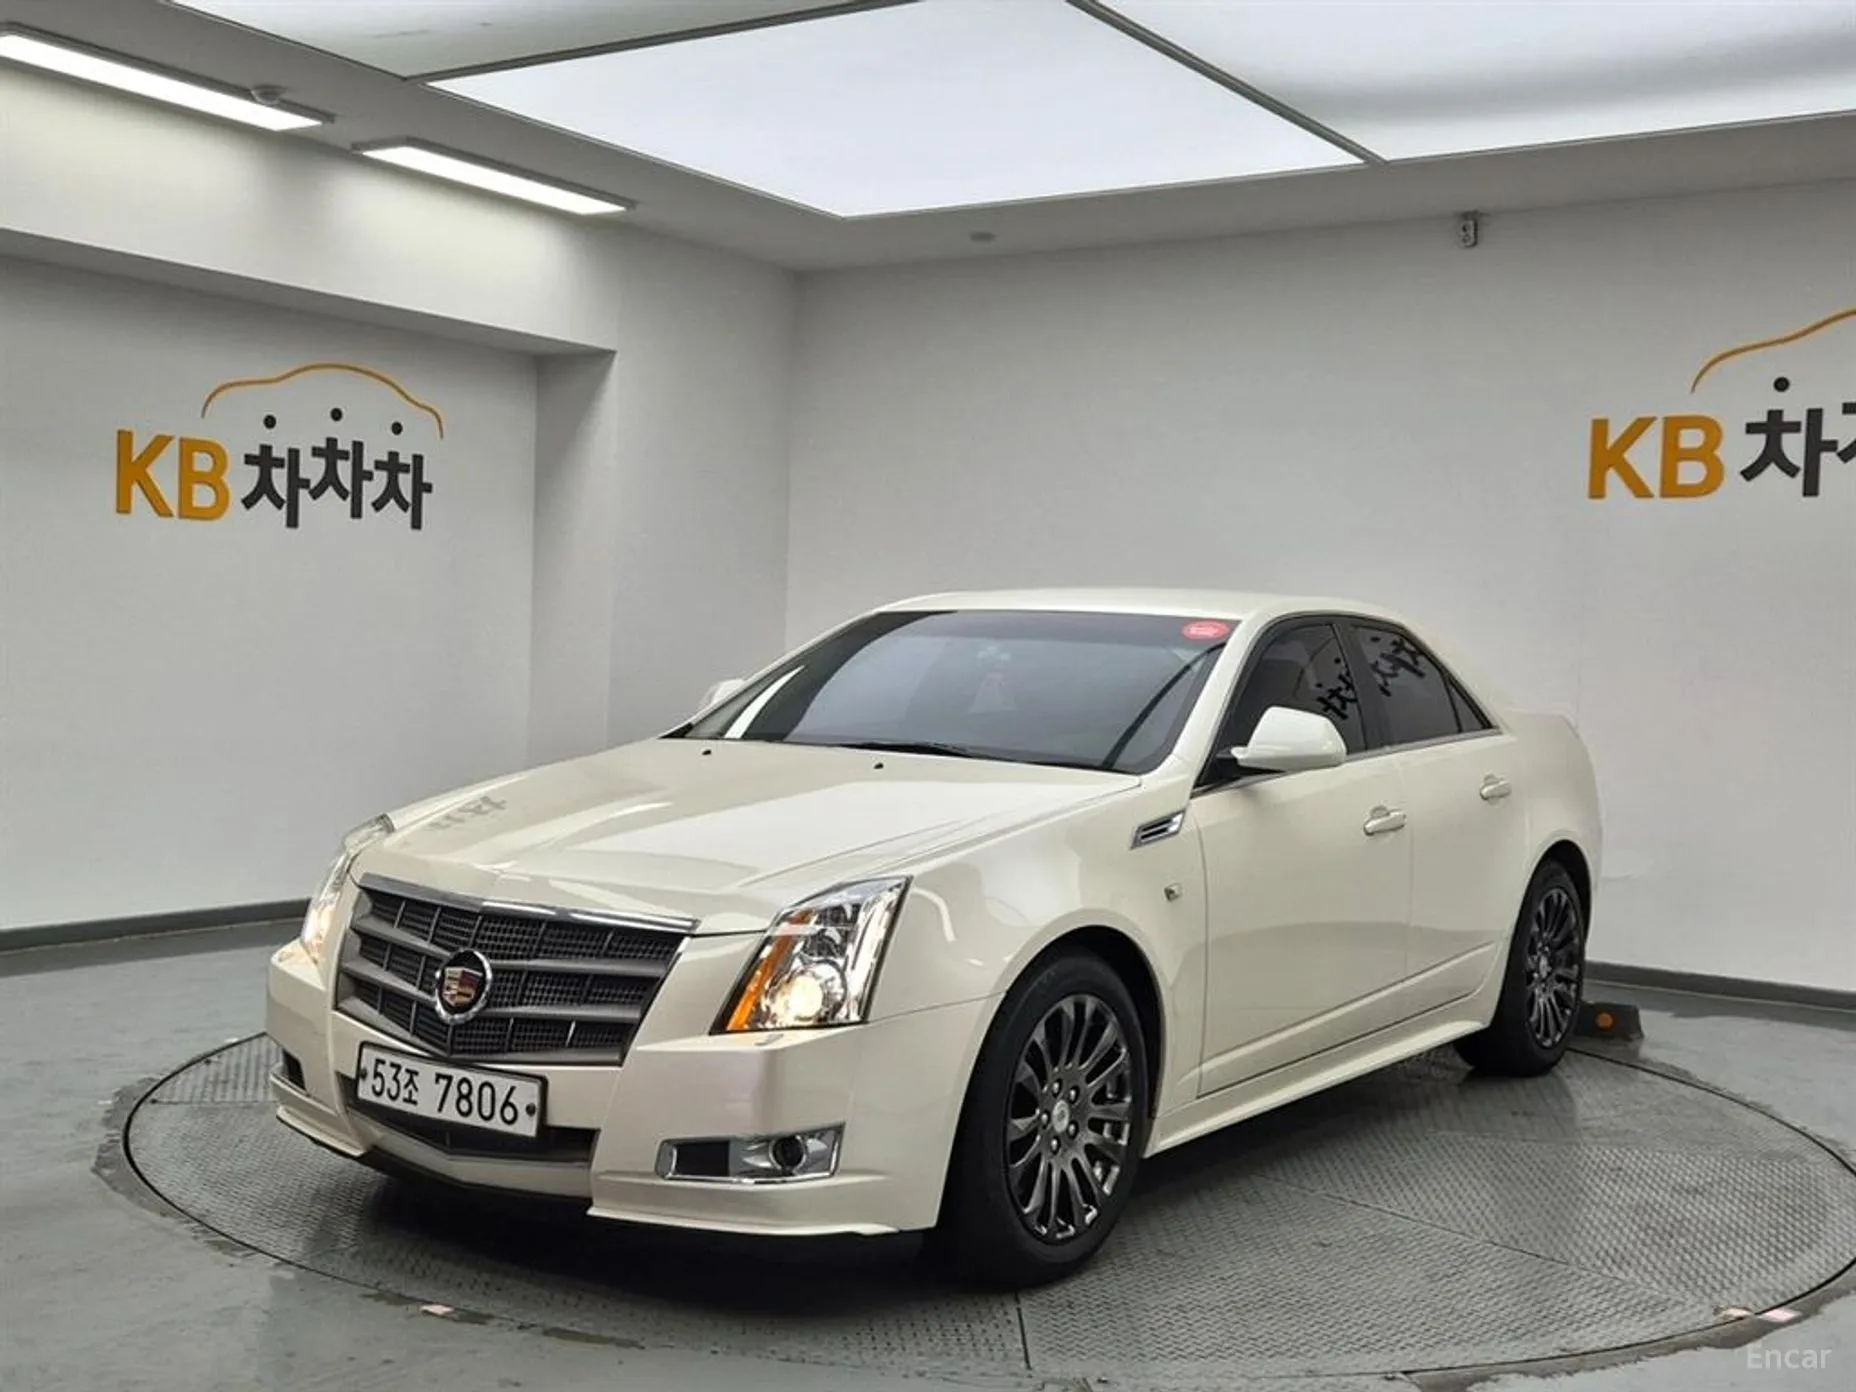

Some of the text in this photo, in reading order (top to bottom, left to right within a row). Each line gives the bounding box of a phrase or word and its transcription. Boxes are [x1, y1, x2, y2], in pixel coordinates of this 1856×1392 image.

[115, 429, 433, 531] KB 차차차
[1588, 414, 1726, 499] KB
[371, 1058, 519, 1126] 53조 7806
